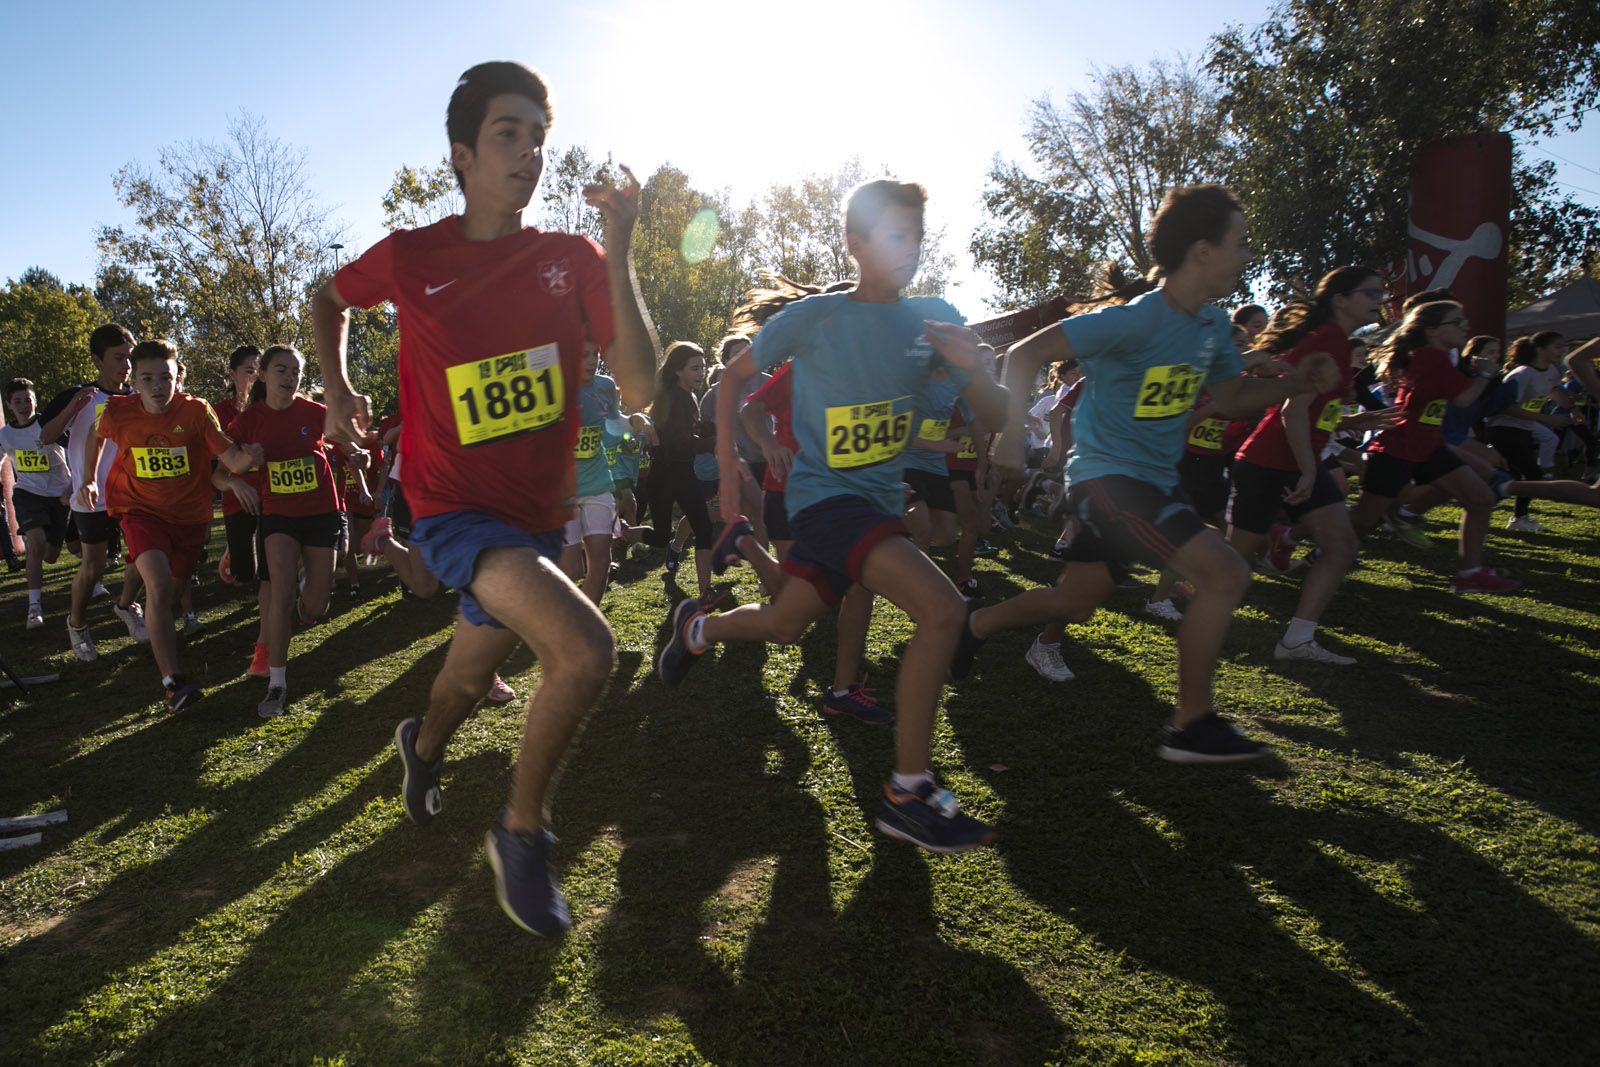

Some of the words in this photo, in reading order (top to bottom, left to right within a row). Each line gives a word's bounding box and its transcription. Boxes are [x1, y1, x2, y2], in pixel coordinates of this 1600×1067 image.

[458, 368, 556, 426] 1881
[831, 415, 908, 455] 2846
[17, 455, 48, 467] 1674
[137, 455, 186, 472] 1883
[271, 466, 315, 487] 5096
